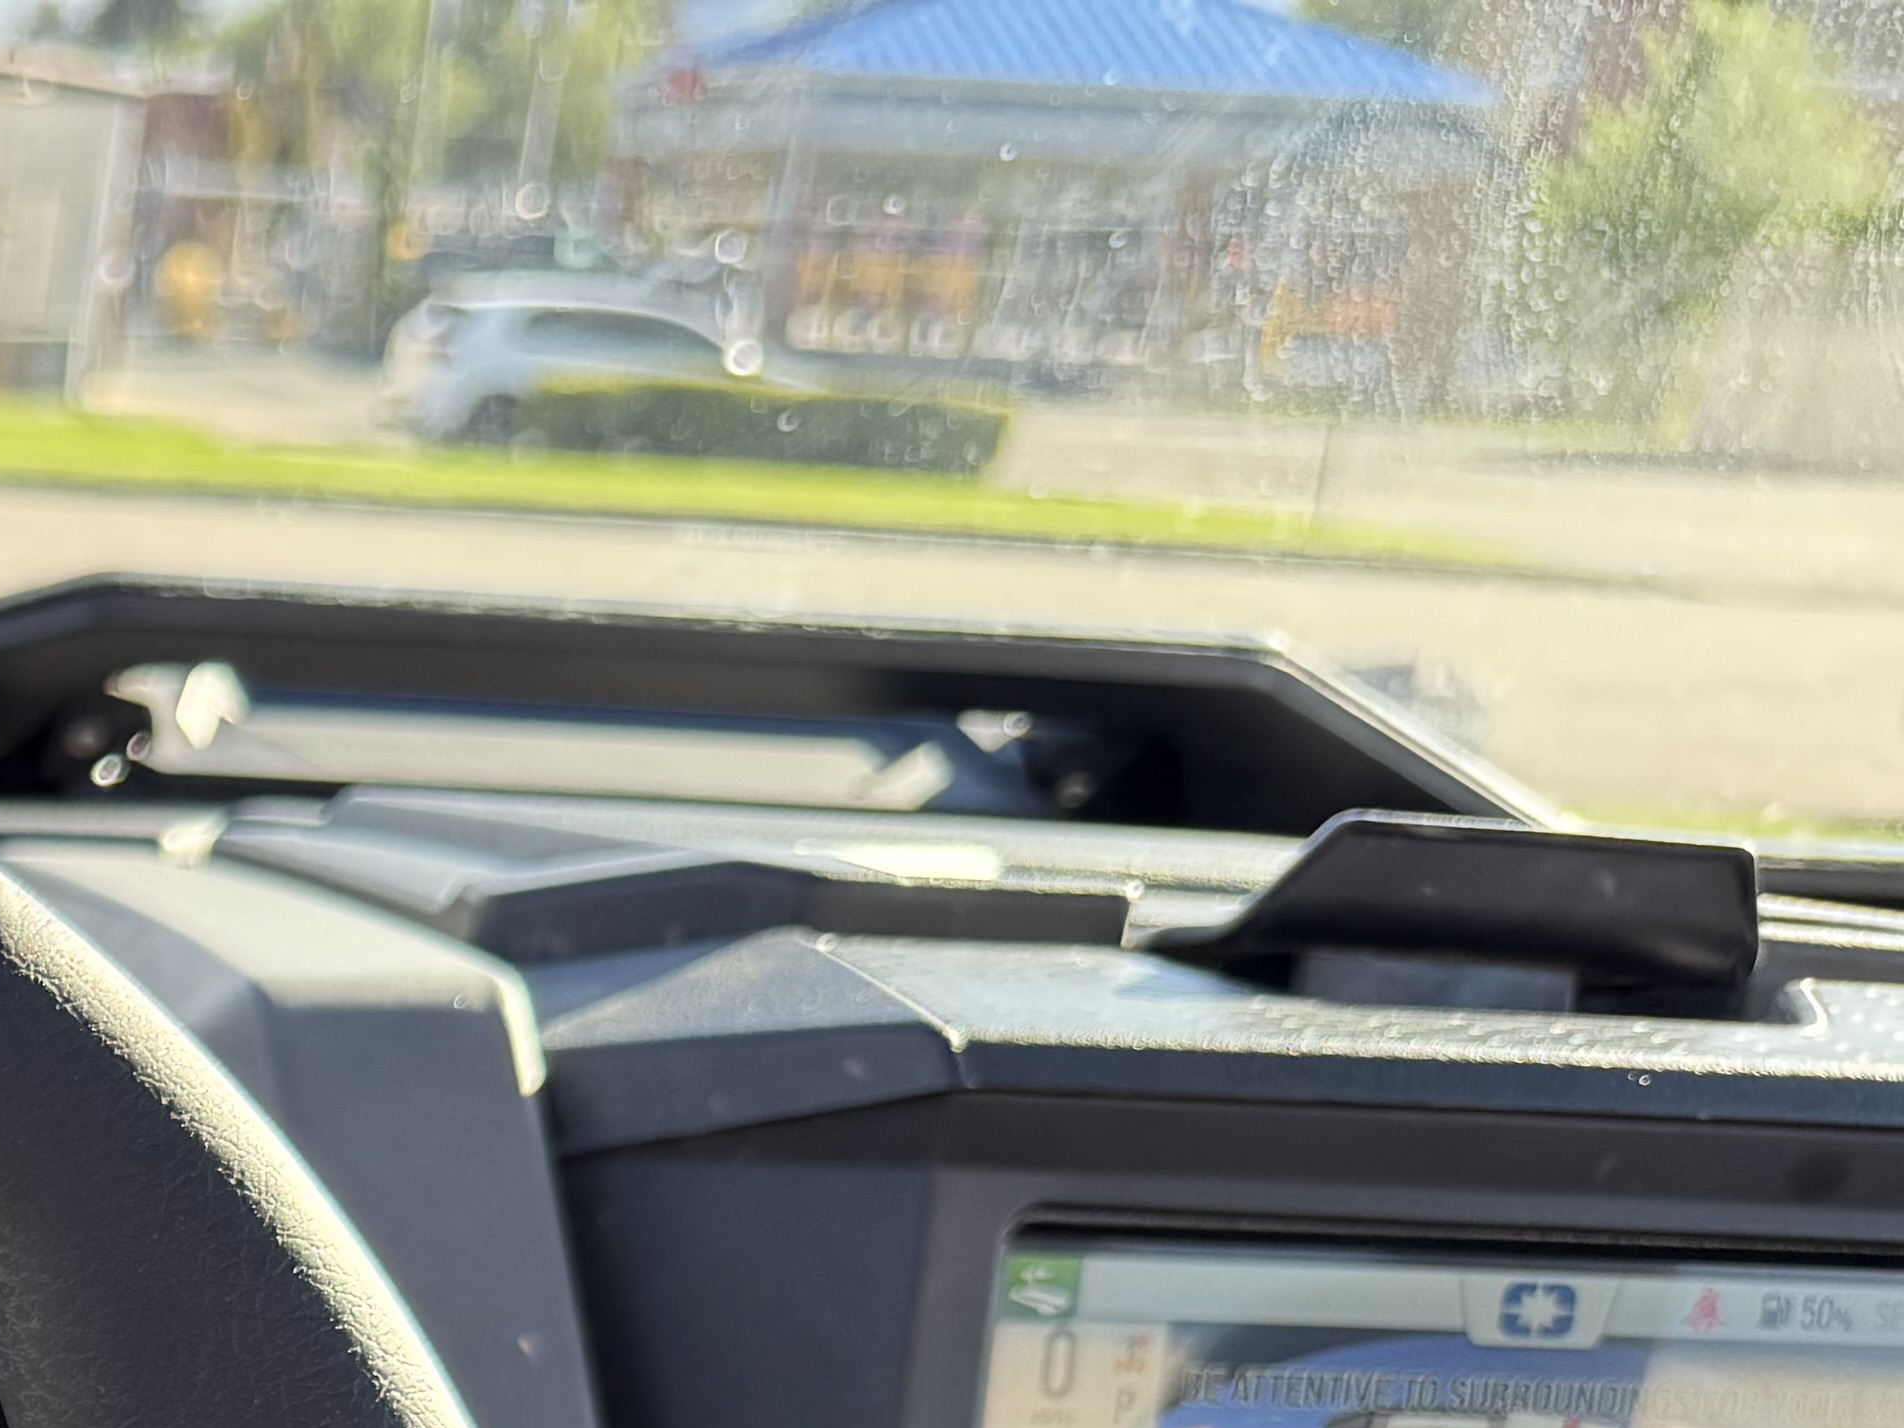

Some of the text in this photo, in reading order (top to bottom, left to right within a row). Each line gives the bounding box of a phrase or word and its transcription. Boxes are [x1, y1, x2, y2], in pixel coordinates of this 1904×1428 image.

[1801, 1295, 1853, 1331] 50%
[1040, 1329, 1077, 1399] 0
[1182, 1367, 1221, 1405] BE
[1231, 1370, 1390, 1409] ATTENTIVE
[1400, 1375, 1438, 1410] TO
[1449, 1378, 1695, 1421] SURROUNDINGS
